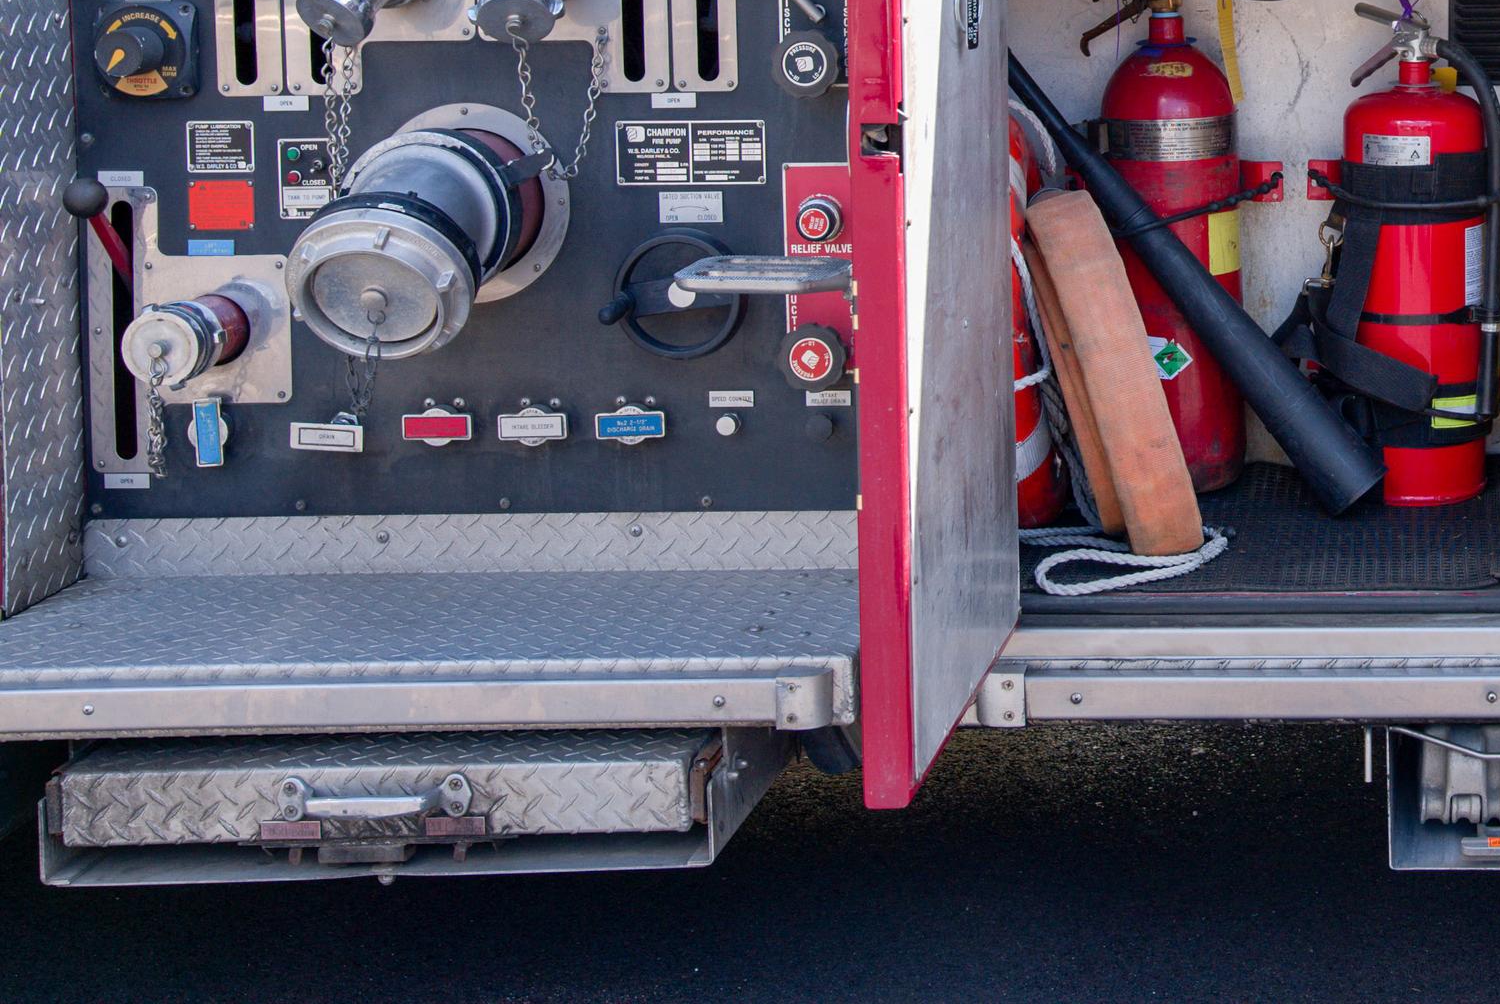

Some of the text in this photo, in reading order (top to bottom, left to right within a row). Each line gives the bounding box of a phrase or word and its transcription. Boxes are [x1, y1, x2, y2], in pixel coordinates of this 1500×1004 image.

[121, 12, 160, 24] INCREASE
[789, 45, 816, 57] PRESSURE
[646, 127, 686, 137] CHAMPION
[791, 244, 853, 254] RELIEF VALVE
